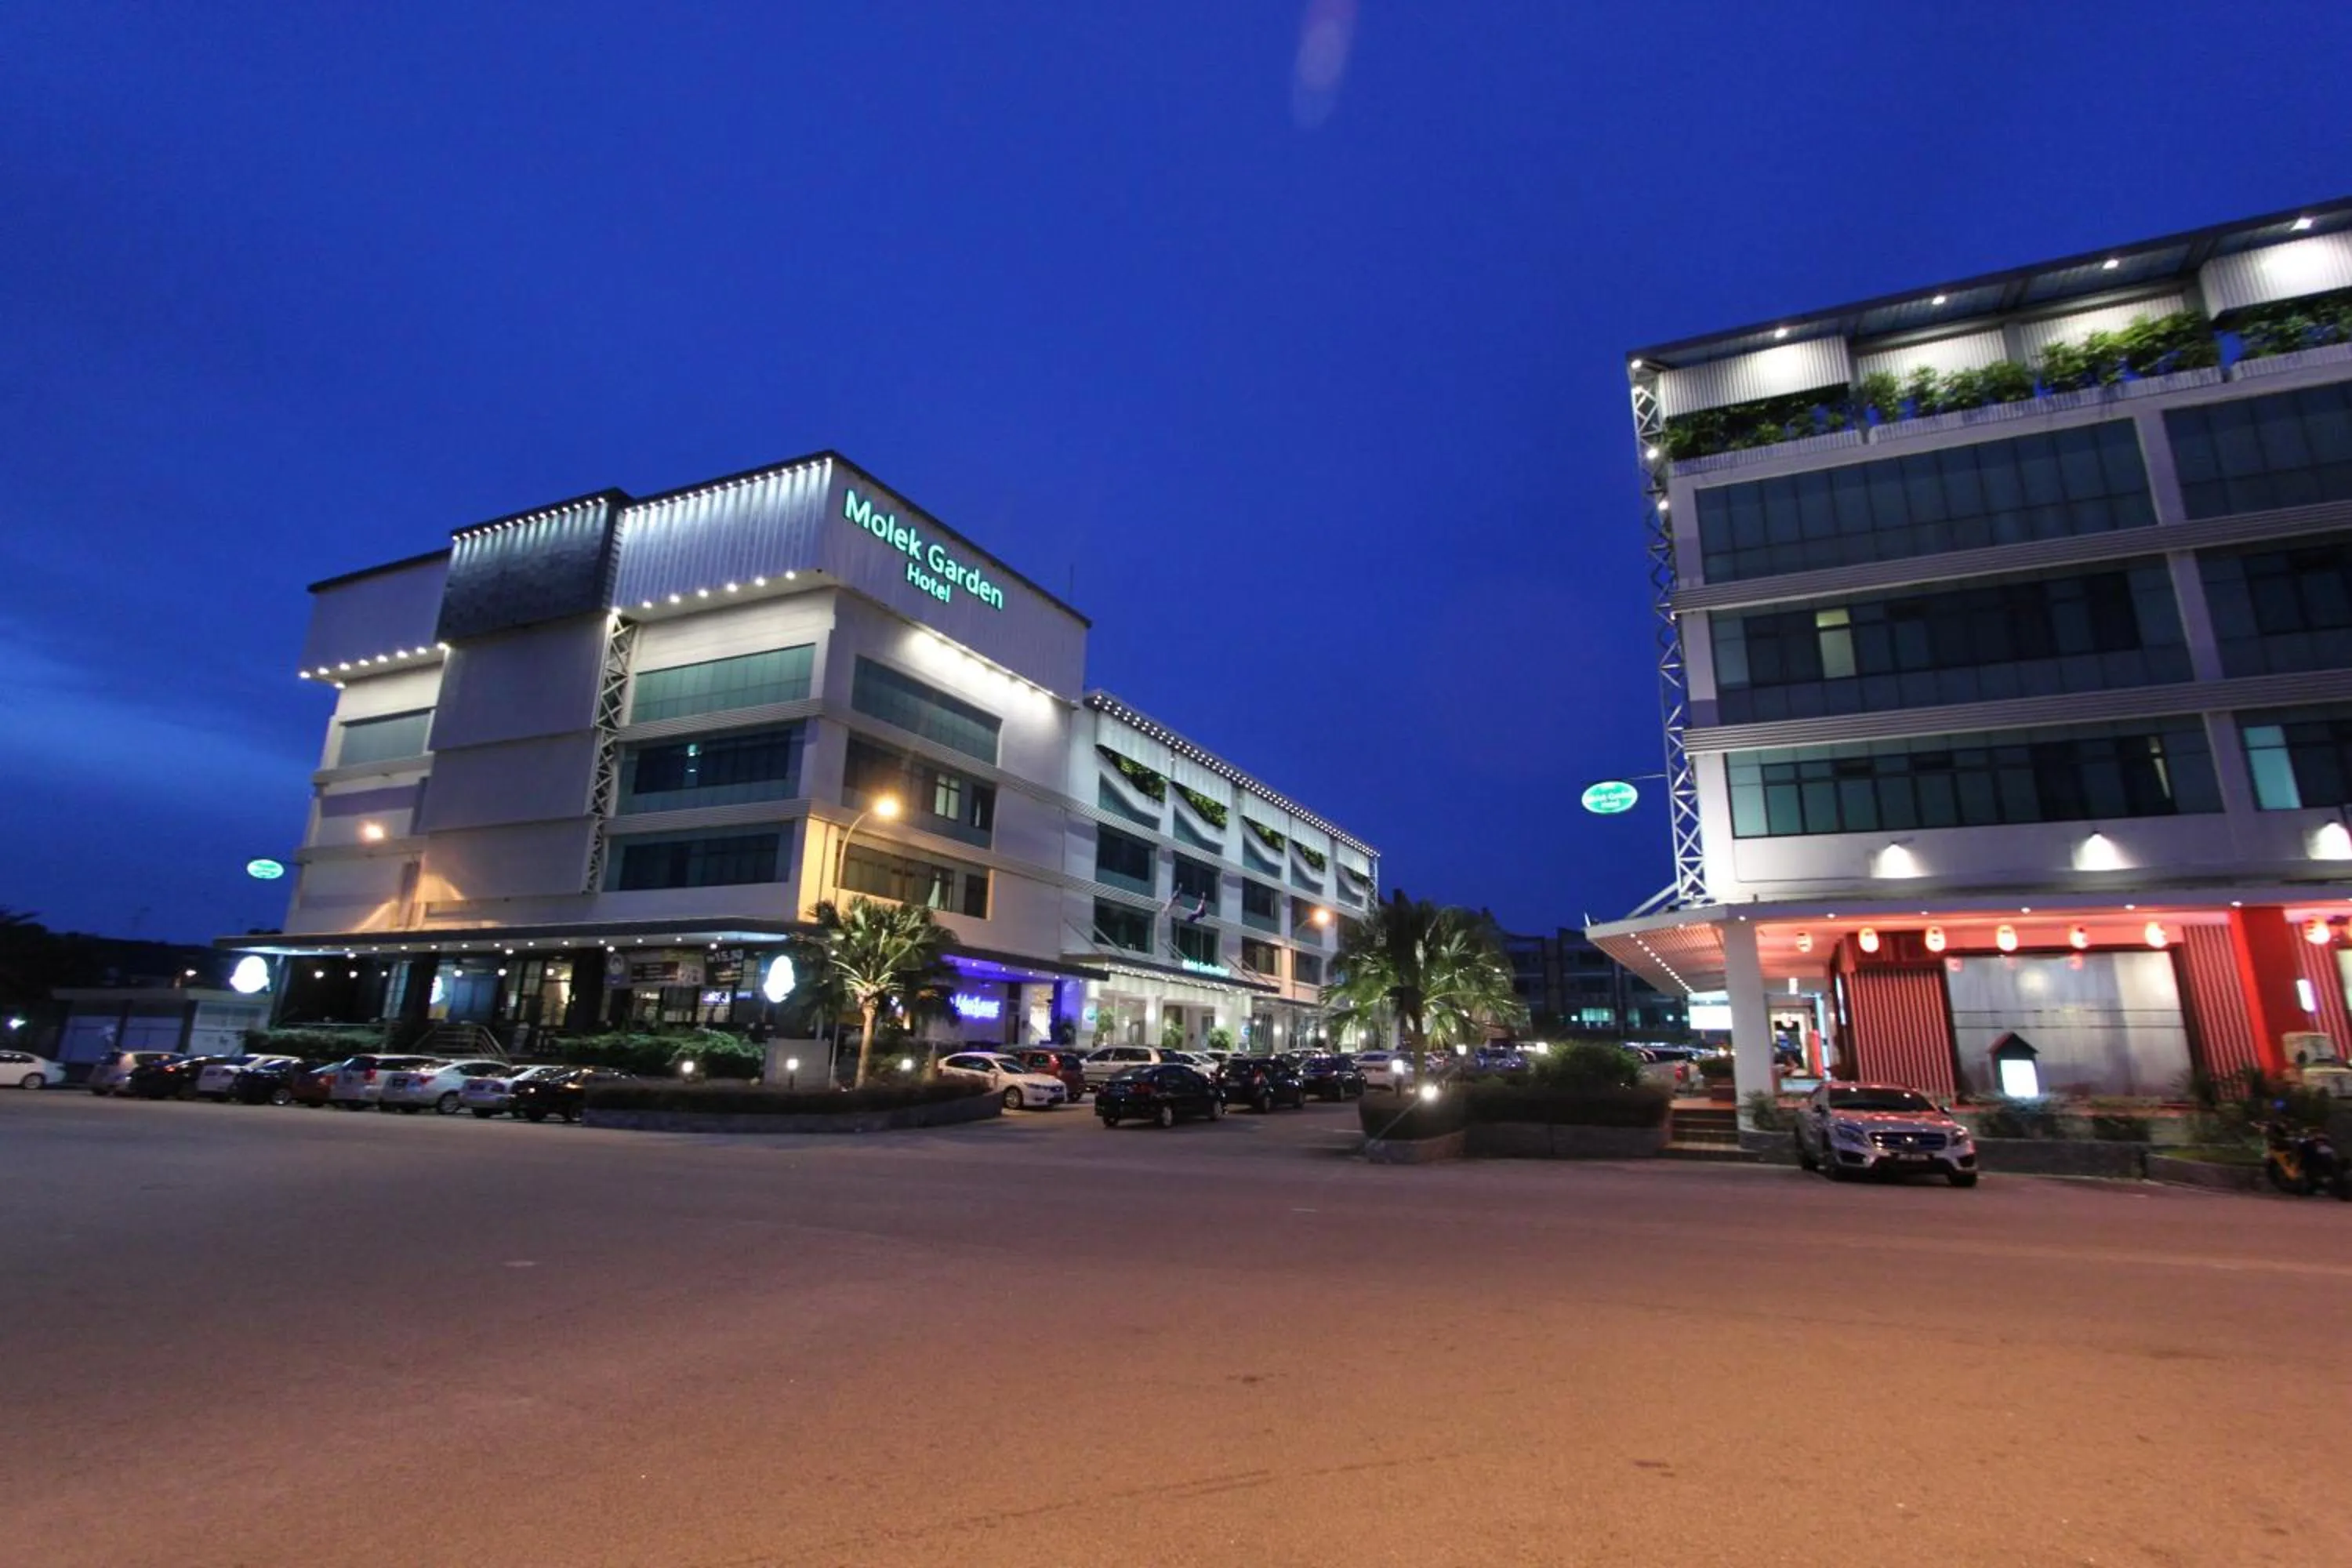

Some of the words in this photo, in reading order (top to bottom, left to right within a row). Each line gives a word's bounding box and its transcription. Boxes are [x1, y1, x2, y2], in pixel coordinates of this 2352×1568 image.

[845, 489, 922, 561] Molek
[927, 544, 1004, 609] Garden
[906, 563, 951, 603] Hotel
